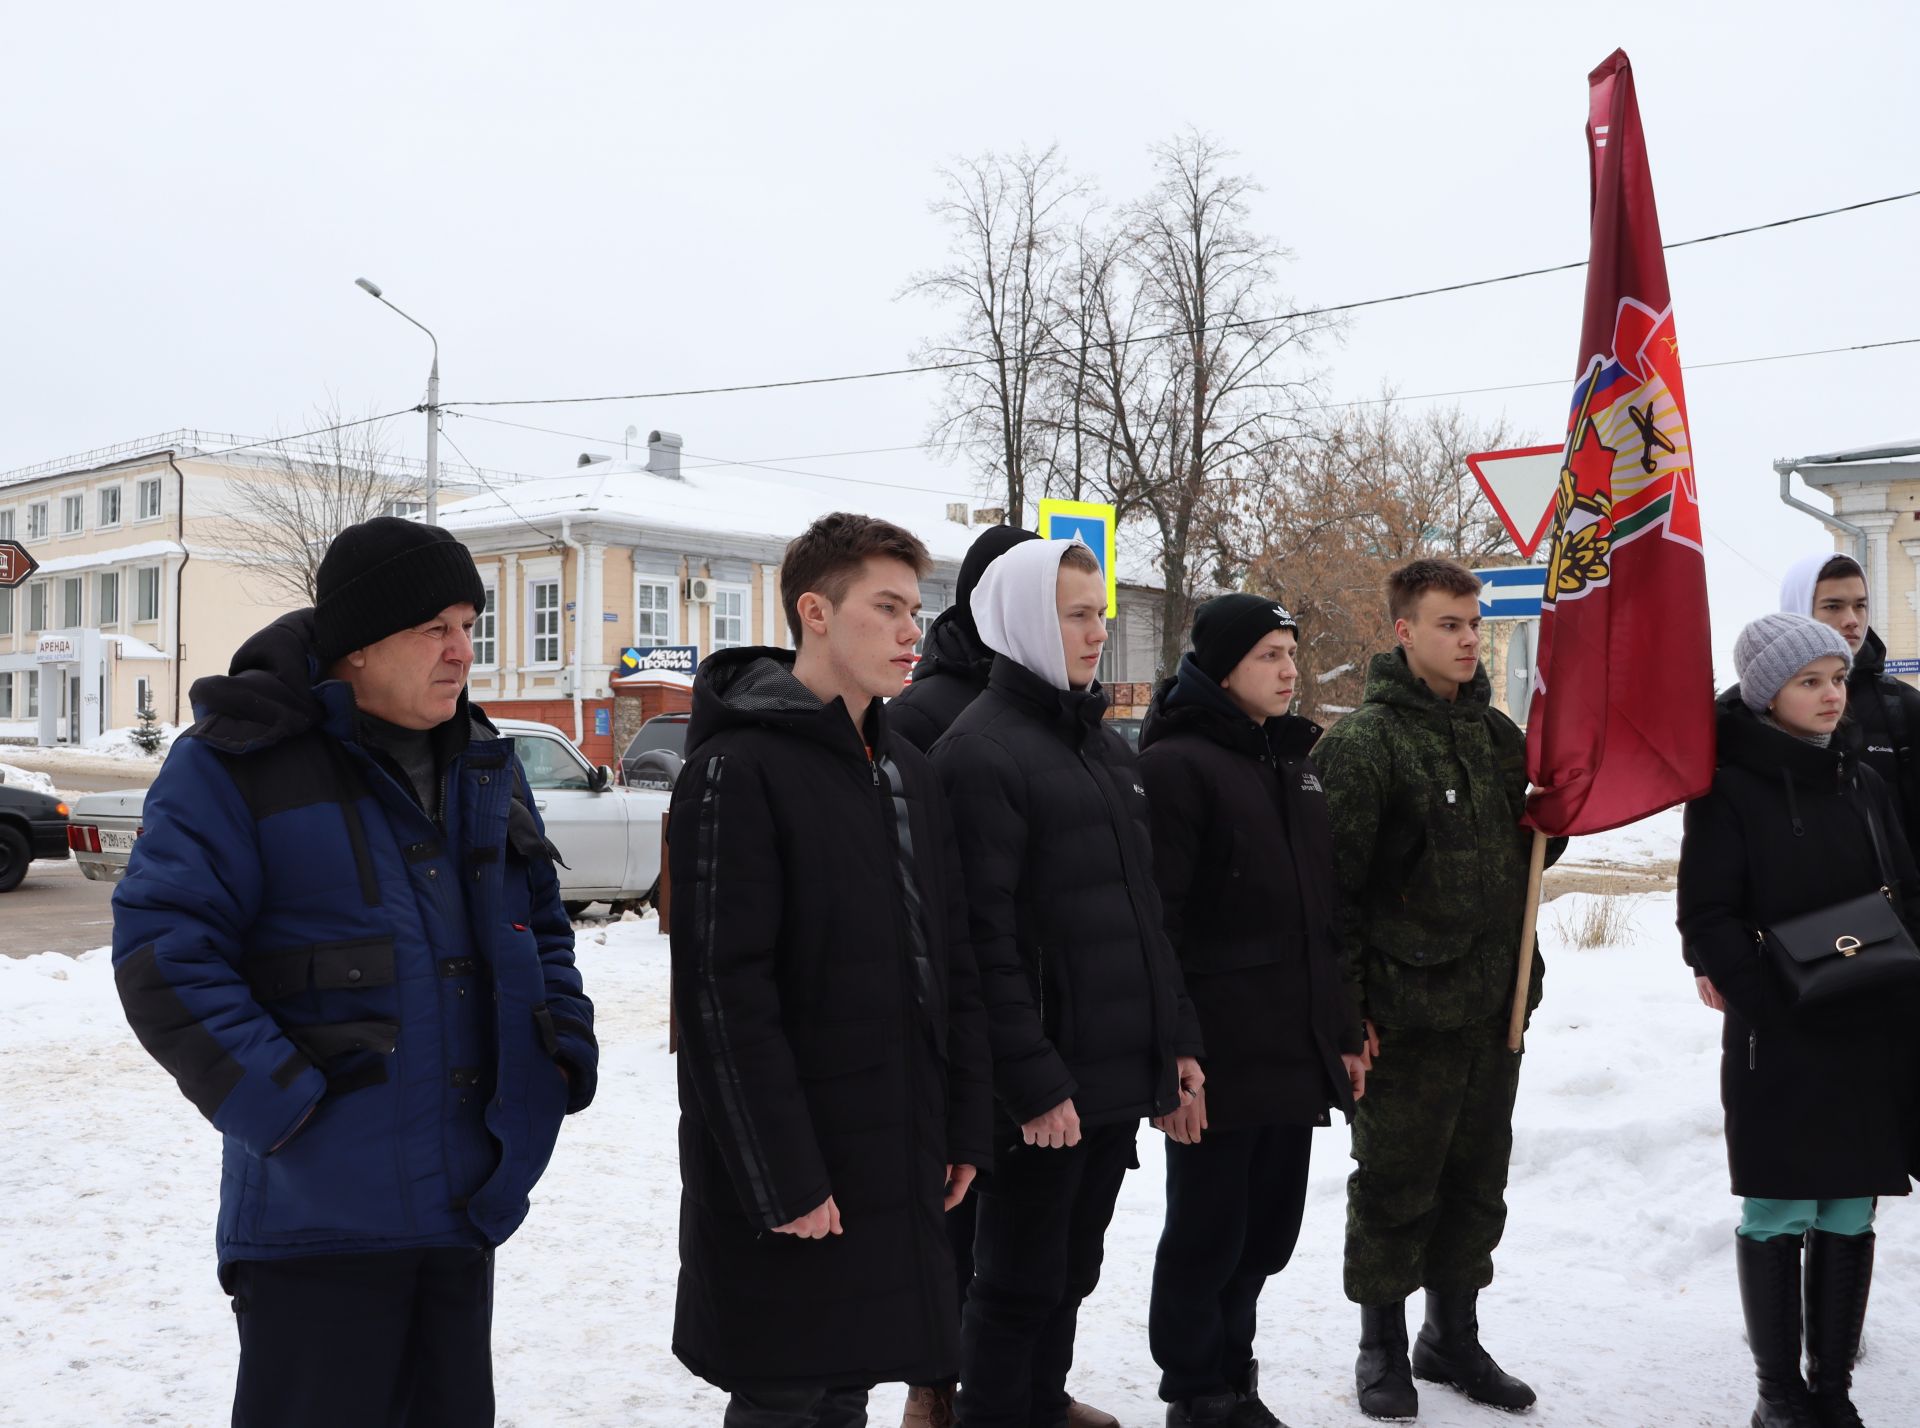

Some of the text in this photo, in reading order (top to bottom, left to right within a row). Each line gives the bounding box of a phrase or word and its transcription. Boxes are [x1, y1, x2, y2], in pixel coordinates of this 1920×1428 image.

[40, 641, 70, 653] АРЕНДА
[648, 649, 692, 660] МЕТАЛЛ
[630, 779, 669, 790] SUZUKI
